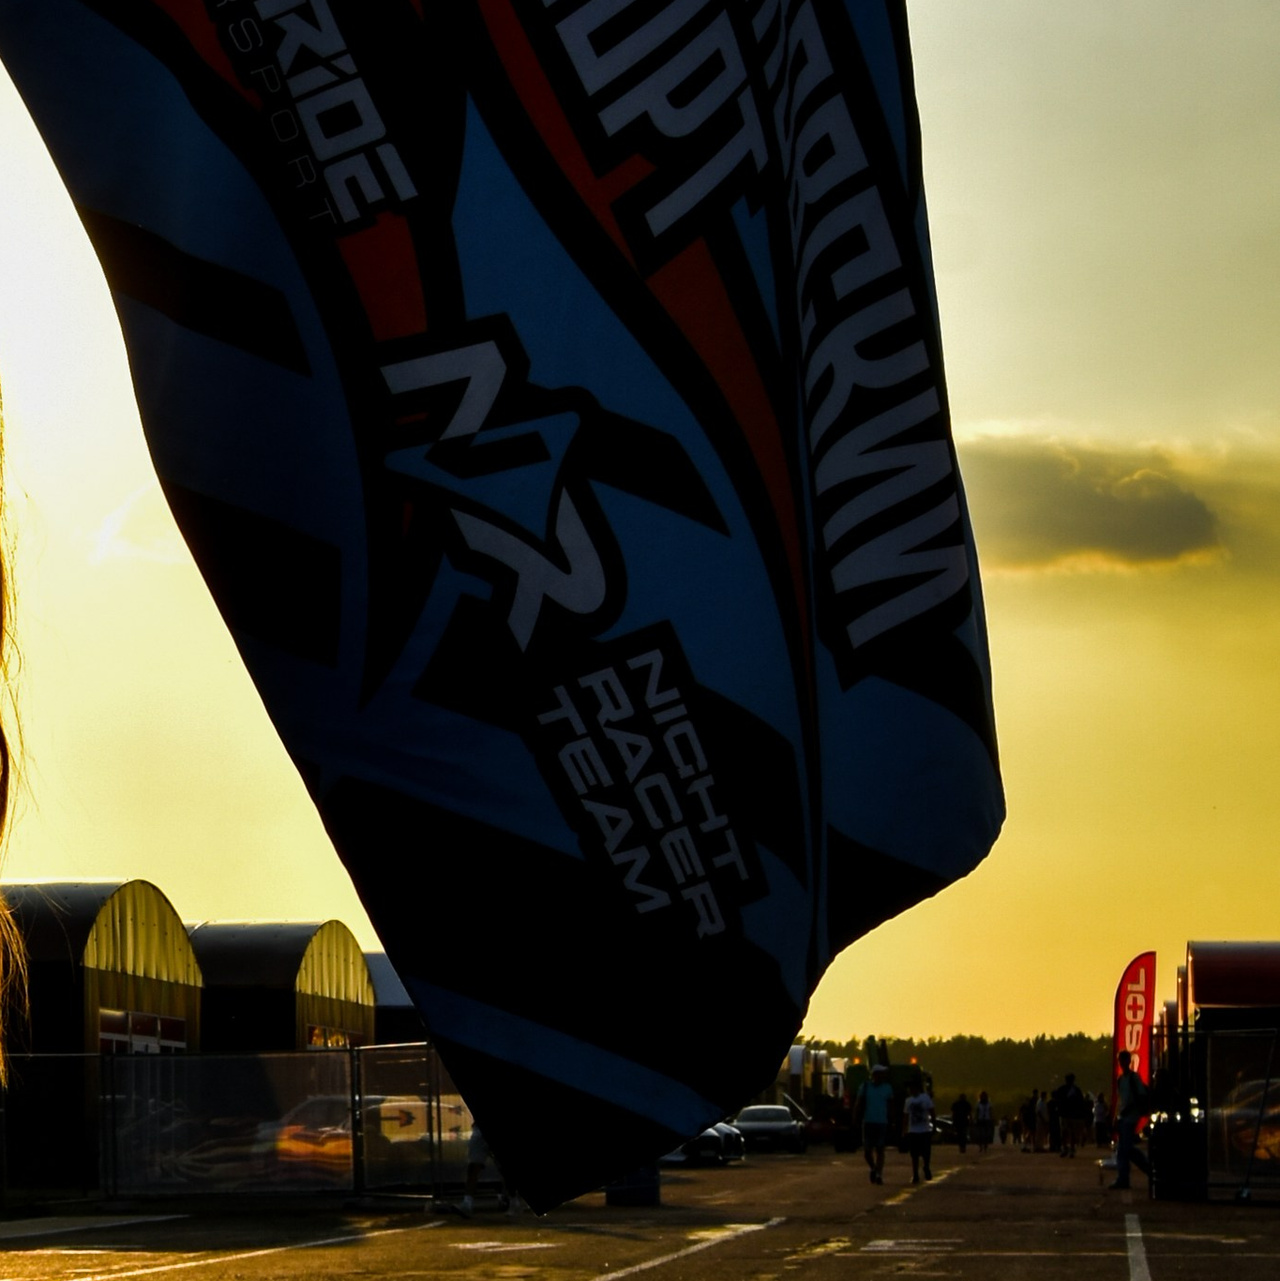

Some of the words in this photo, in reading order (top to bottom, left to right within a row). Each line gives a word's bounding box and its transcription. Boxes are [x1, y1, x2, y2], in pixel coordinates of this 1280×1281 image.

[536, 684, 671, 914] TEAM
[577, 667, 726, 940] RACER
[625, 648, 750, 881] NIGHT
